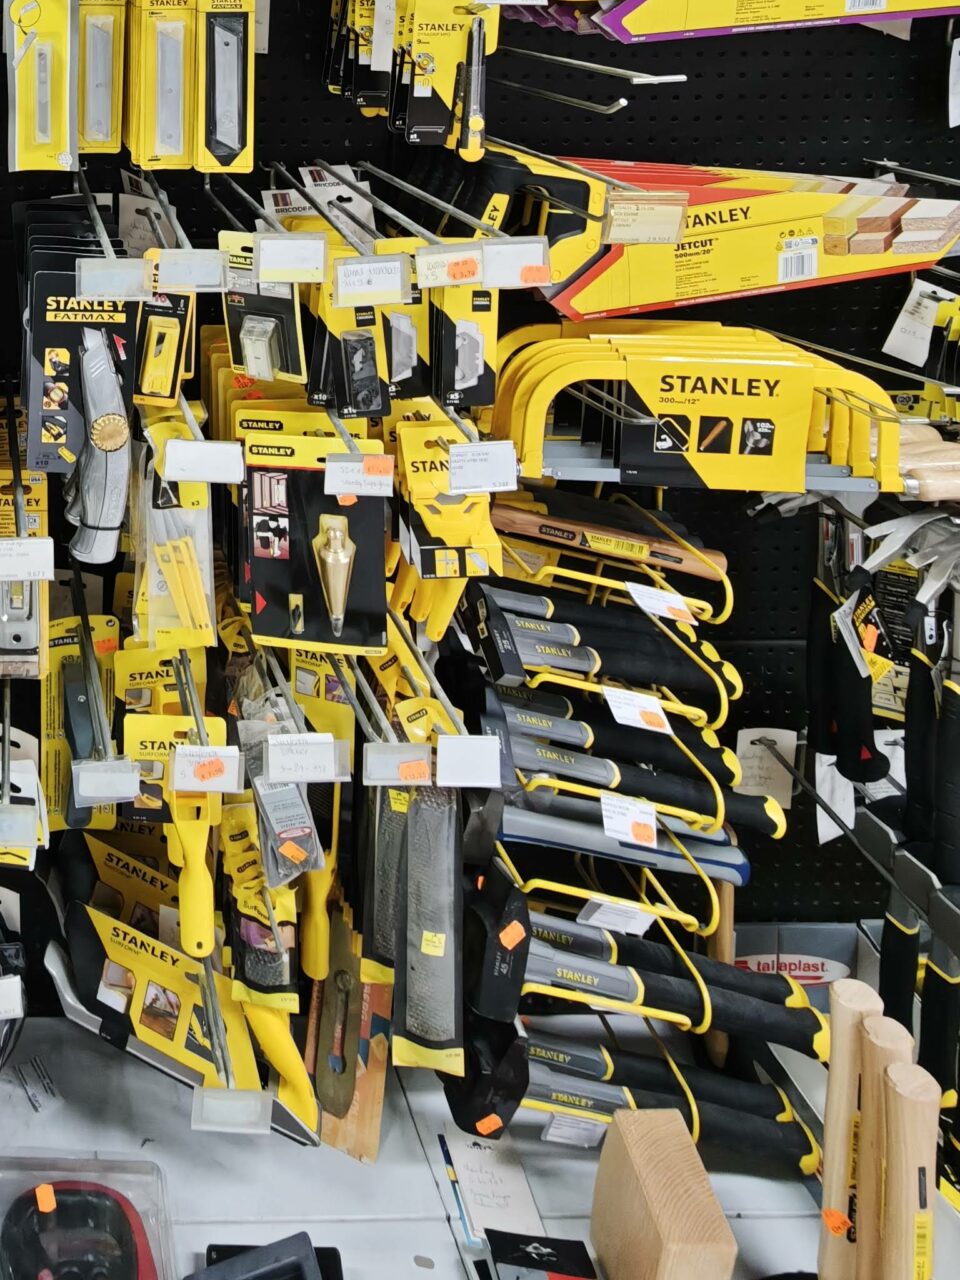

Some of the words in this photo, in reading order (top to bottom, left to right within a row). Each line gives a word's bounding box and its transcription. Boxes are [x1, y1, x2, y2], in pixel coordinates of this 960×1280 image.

[150, 0, 189, 7] STANLEY
[418, 23, 465, 32] STANLEY
[684, 206, 752, 229] TANLEY
[674, 239, 714, 252] JETCUT
[53, 313, 116, 321] FATMAX
[659, 374, 781, 398] STANLEY
[242, 421, 281, 430] STANLEY
[251, 446, 293, 456] STANLEY
[541, 526, 574, 540] STANLEY
[515, 620, 551, 633] STANLEY
[535, 645, 572, 657] STANLEY
[516, 713, 553, 728] STANLEY
[536, 747, 575, 765] STANLEY
[105, 853, 169, 891] STANLEY
[531, 927, 574, 945] STANLEY
[111, 926, 180, 967] STANLEY
[556, 968, 599, 986] STANLEY
[528, 1046, 572, 1064] STANLEY
